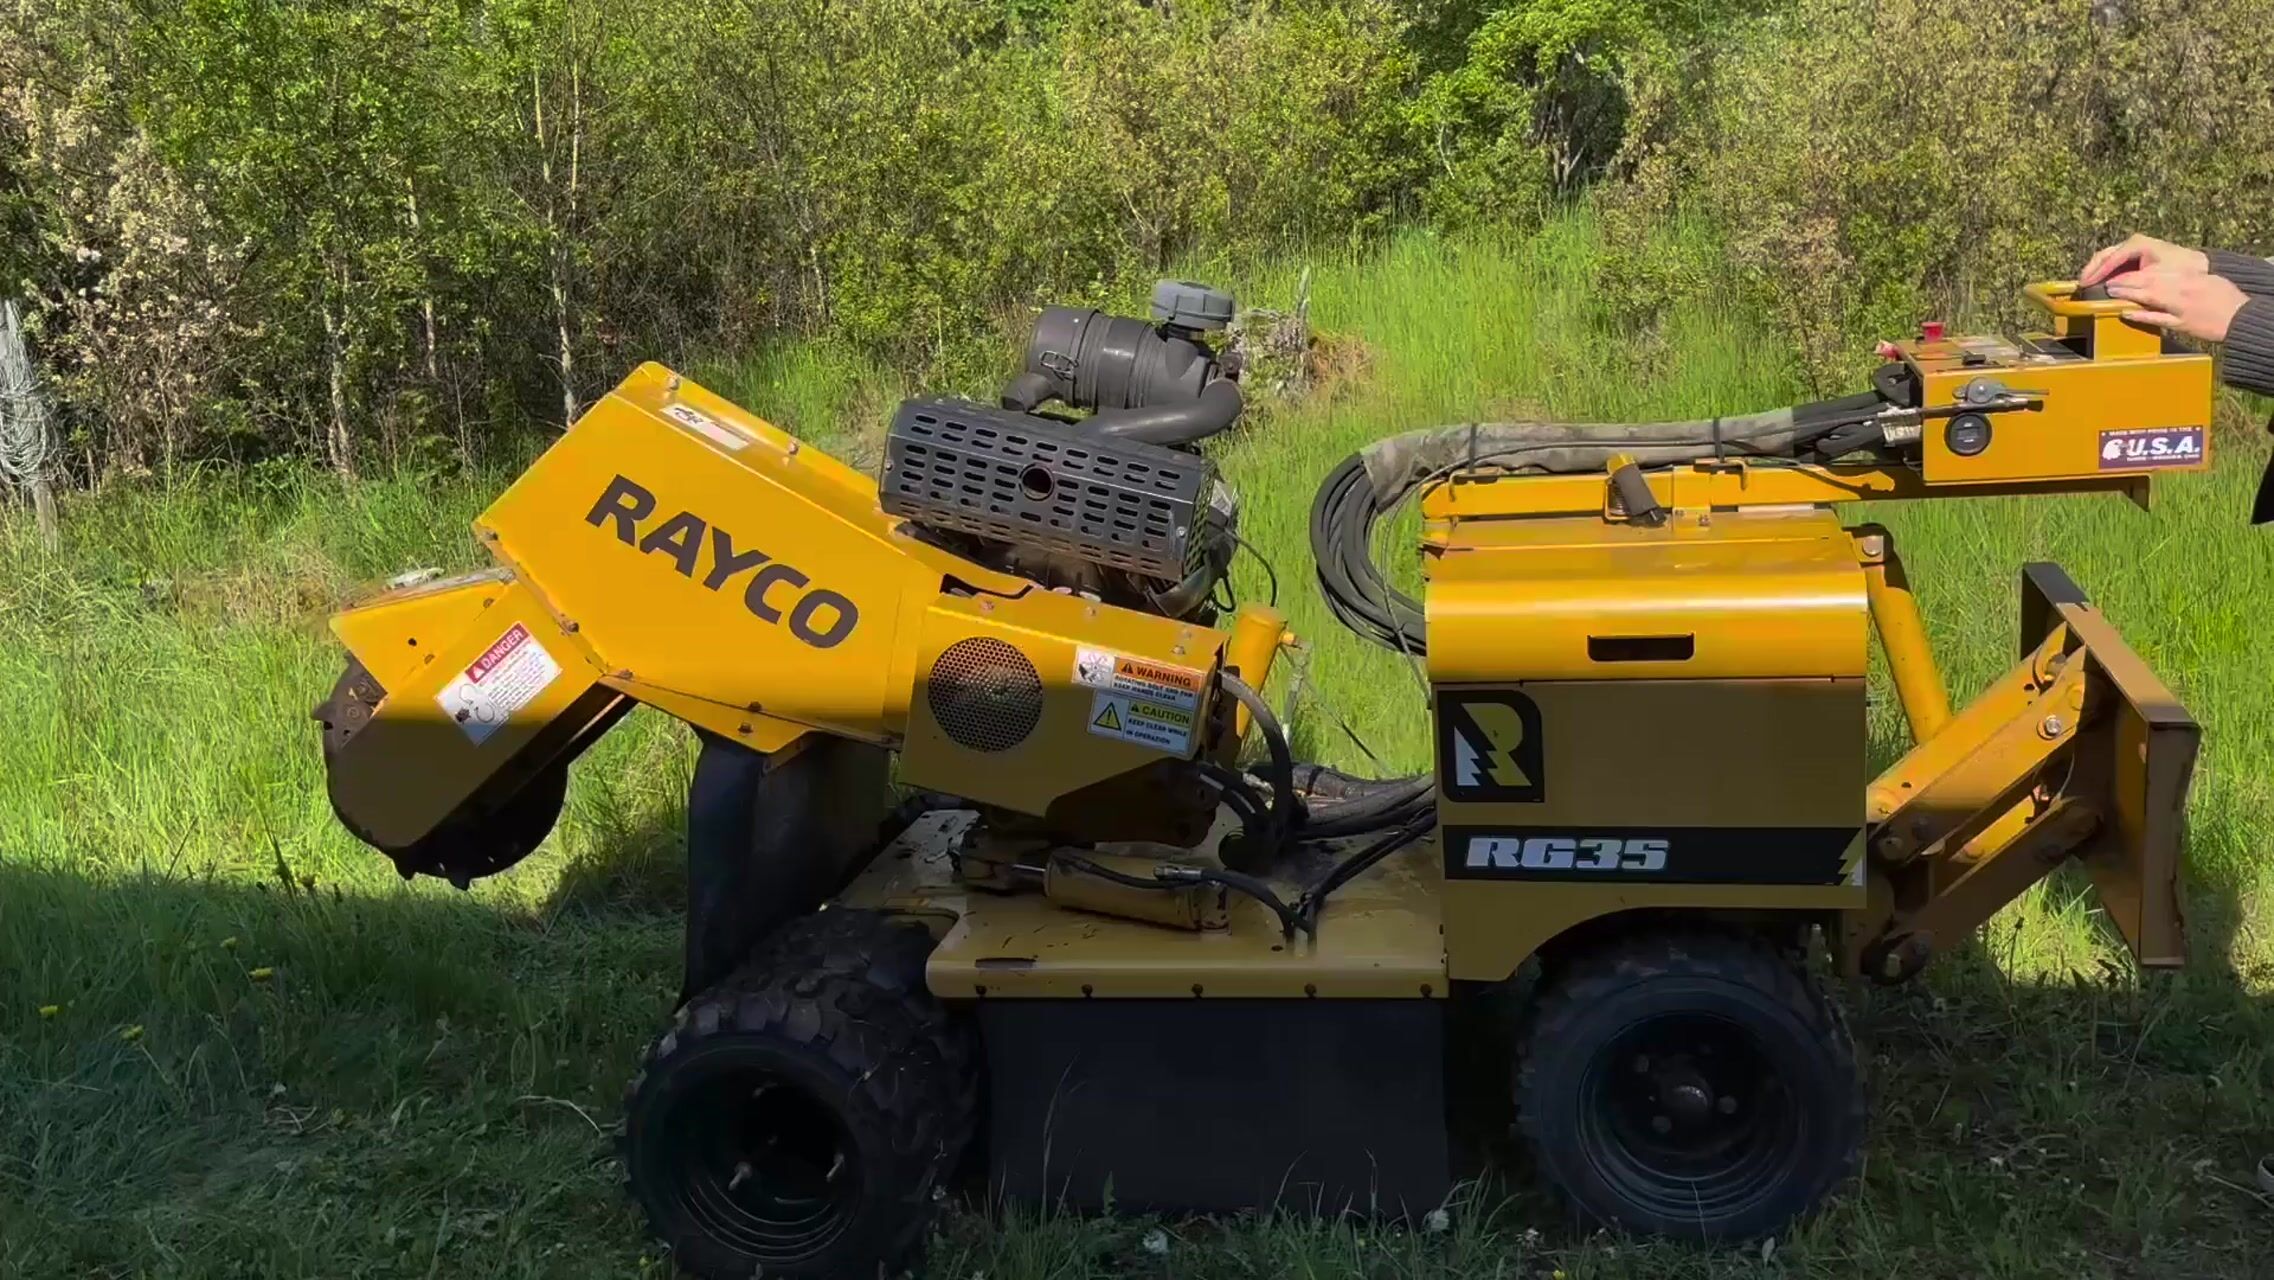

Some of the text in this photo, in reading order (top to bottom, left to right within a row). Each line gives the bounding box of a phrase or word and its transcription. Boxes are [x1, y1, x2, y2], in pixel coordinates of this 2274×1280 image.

[2127, 436, 2200, 456] U.S.A.
[585, 474, 859, 648] RAYCO
[483, 628, 523, 669] DANGER
[1137, 666, 1191, 687] WARNING
[1142, 705, 1189, 723] CAUTION
[1466, 837, 1669, 870] RG35
